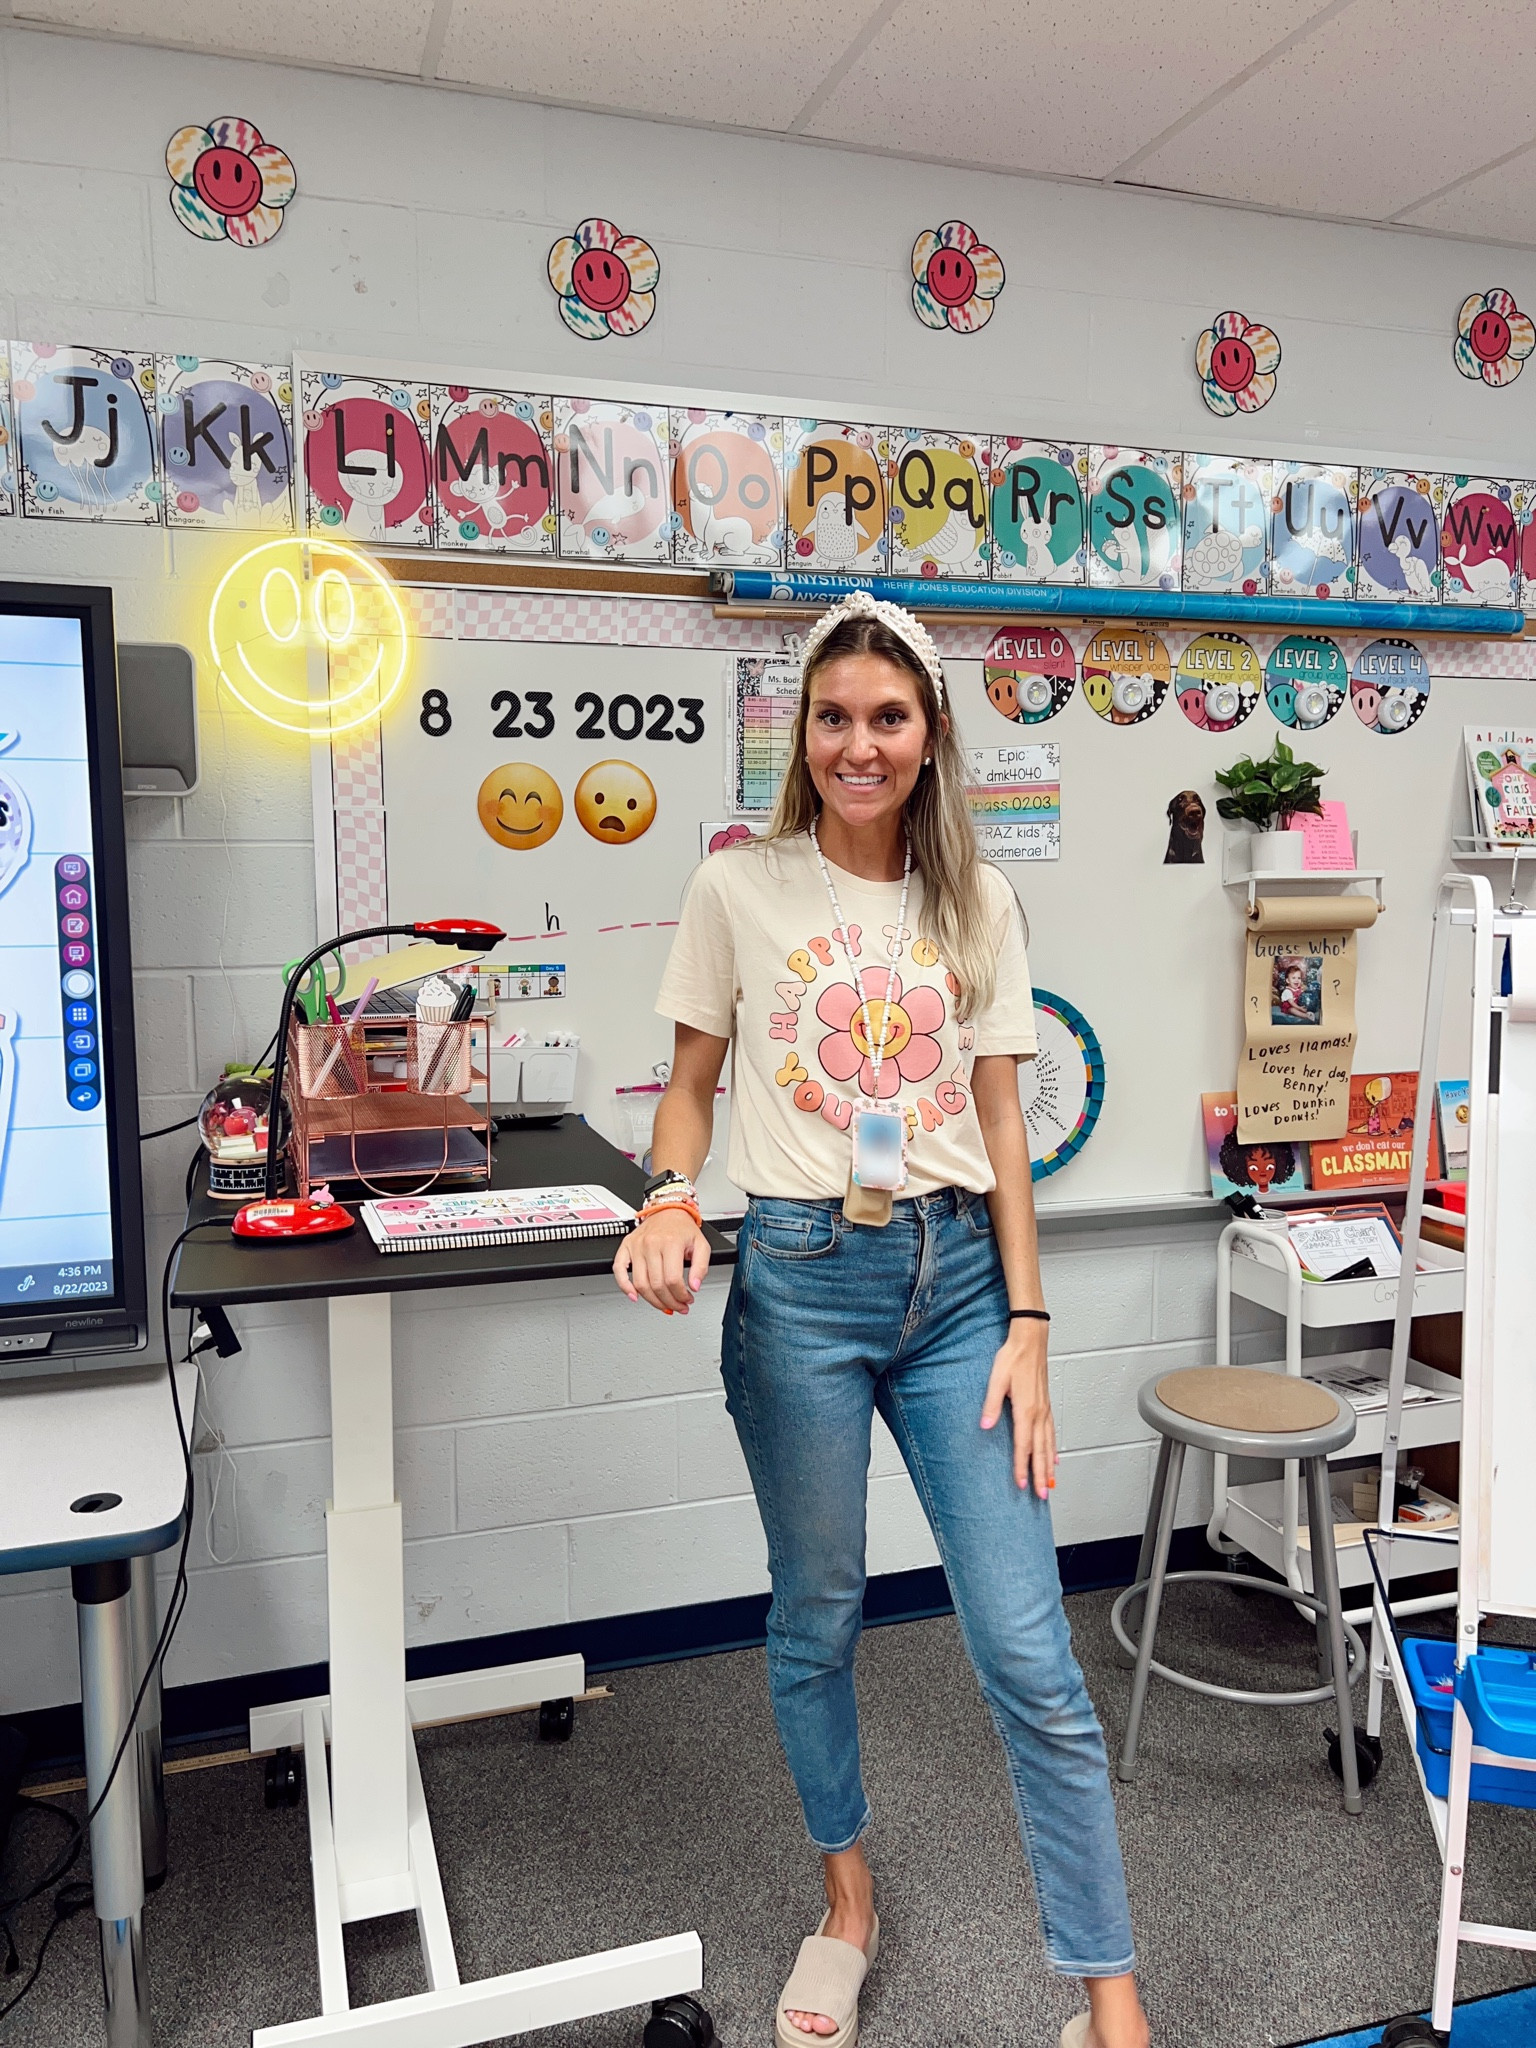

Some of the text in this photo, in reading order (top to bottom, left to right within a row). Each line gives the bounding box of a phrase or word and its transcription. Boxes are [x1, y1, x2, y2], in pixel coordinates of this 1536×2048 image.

[41, 375, 118, 468] Jj
[183, 399, 276, 474] Kk
[437, 423, 548, 489] Mm
[569, 423, 659, 499] Nn
[687, 443, 771, 510] Oo
[806, 446, 876, 527] Pp
[899, 449, 986, 529] Qq
[1011, 464, 1076, 526] Rr
[1105, 470, 1167, 530] Ss
[1199, 477, 1254, 535] Tt
[27, 505, 65, 516] jelly fish
[168, 515, 206, 524] kangaroo
[1285, 481, 1344, 541] Uu
[1372, 493, 1428, 550] Vv
[1447, 502, 1515, 549] Ww
[440, 540, 469, 549] monkey
[561, 548, 591, 556] narwhal
[677, 555, 695, 563] otter
[787, 561, 813, 569] penguin
[893, 566, 909, 575] quail
[796, 573, 1047, 597] NYSTROM HERFF JONES EDUCATION DIVISION
[1090, 579, 1115, 587] squirrel
[993, 638, 1046, 660] LEVEL
[1091, 640, 1142, 661] LEVEL
[1043, 659, 1066, 669] silent
[1110, 660, 1169, 672] whisper voice
[1186, 649, 1252, 671] LEVEL 2
[1275, 648, 1339, 671] LEVEL 3
[1360, 654, 1422, 675] LEVEL 4
[768, 675, 782, 683] Ms.
[1202, 671, 1260, 683] partner voice
[1299, 671, 1346, 681] group voice
[1379, 675, 1429, 684] outside voice
[420, 689, 705, 744] 8 23 2023
[986, 767, 1042, 783] dmk4040
[985, 827, 1013, 840] RAZ
[545, 901, 560, 931] h
[1254, 934, 1347, 958] Guess Who!
[1249, 1033, 1352, 1061] Loves llamas!
[1262, 1062, 1349, 1083] Loves her dog,
[1283, 1078, 1329, 1097] Benny!
[1293, 1097, 1336, 1111] Dunkin
[1274, 1111, 1319, 1126] Donuts!
[1342, 1140, 1406, 1153] we don't eat our
[480, 1211, 582, 1227] RULE
[1297, 1225, 1377, 1243] SWBST Chart
[1359, 1236, 1379, 1244] STORY
[58, 1264, 102, 1278] 4:36 PM
[53, 1281, 108, 1296] 8/22/2023
[65, 1316, 104, 1328] newline
